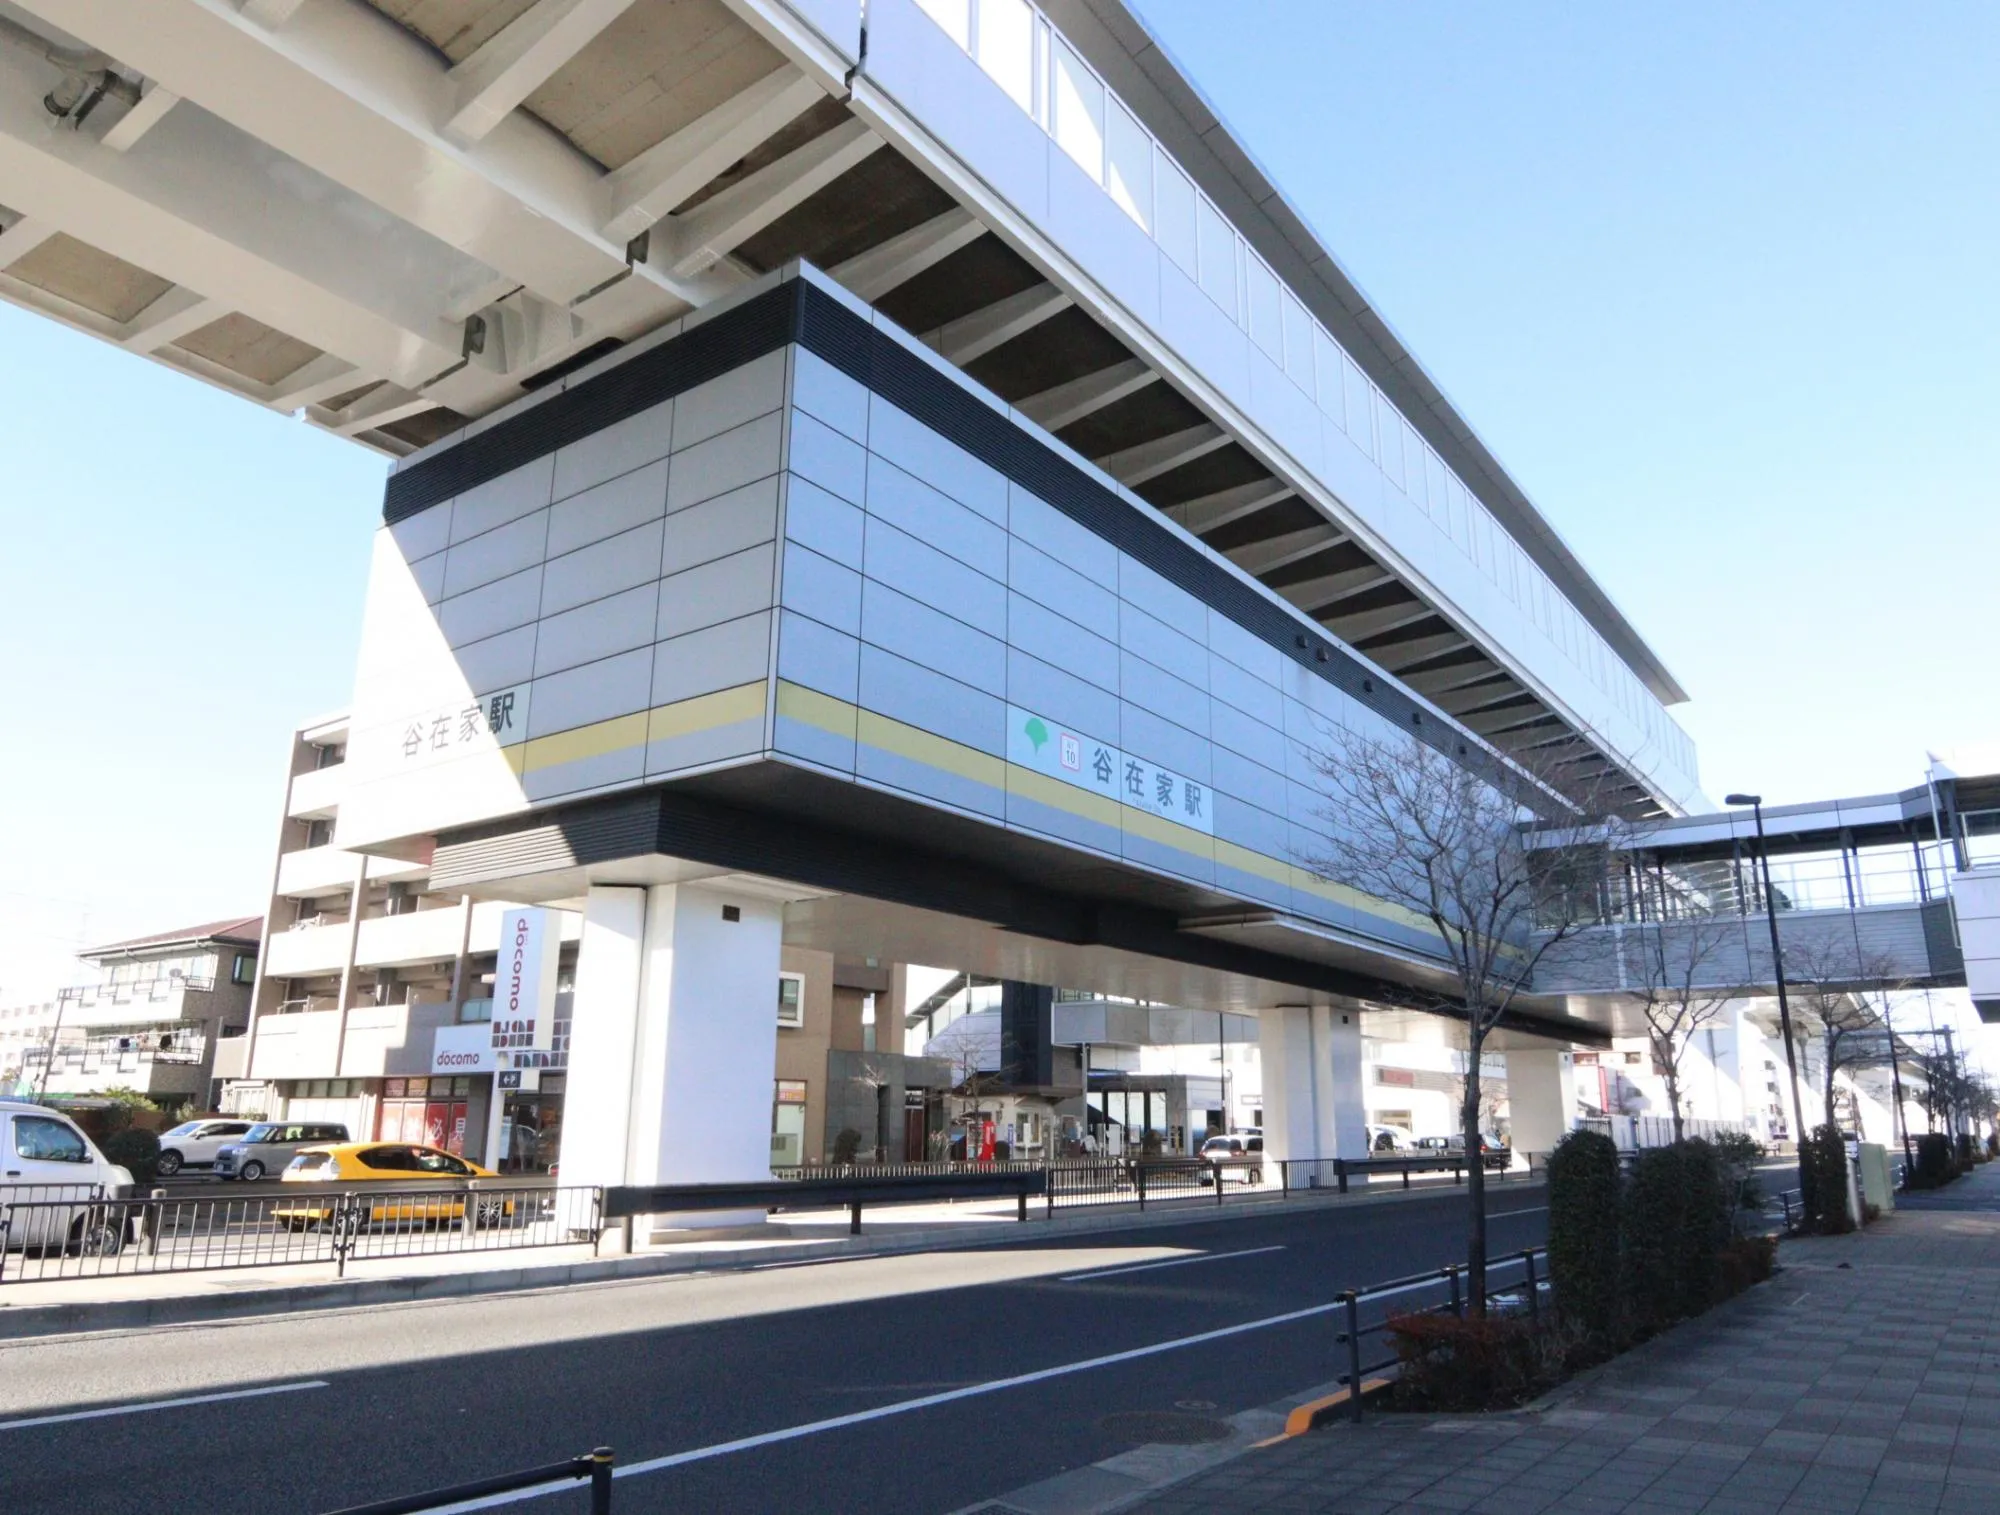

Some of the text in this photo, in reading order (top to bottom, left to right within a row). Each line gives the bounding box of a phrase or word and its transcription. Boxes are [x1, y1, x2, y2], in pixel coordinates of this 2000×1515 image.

[402, 691, 515, 759] 谷在家駅
[1066, 750, 1076, 765] 10
[1092, 747, 1203, 819] 谷在家駅
[510, 918, 528, 1011] docomo
[436, 1050, 480, 1066] docomo
